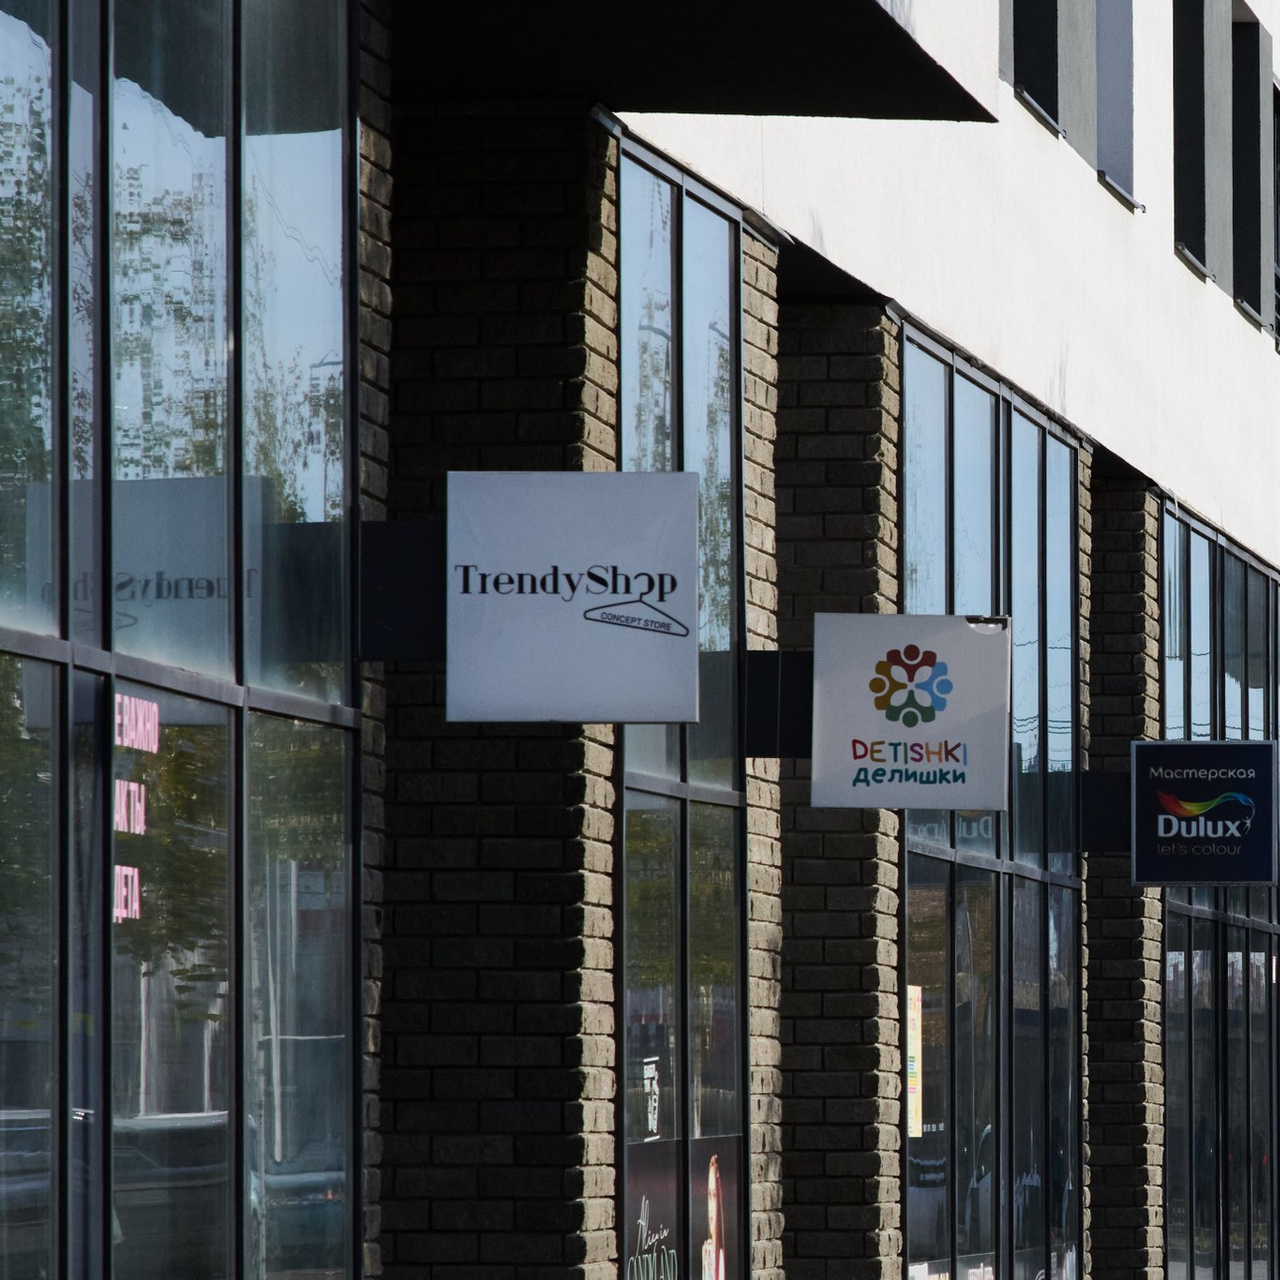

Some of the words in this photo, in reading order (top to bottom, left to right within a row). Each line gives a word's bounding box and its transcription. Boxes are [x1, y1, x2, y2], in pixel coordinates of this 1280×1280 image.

[454, 565, 678, 603] TrendyShop
[600, 611, 642, 626] CONCEPT
[643, 619, 672, 632] STORE
[114, 693, 122, 746] Е
[123, 695, 160, 754] ВАЖНО
[851, 738, 968, 766] DETISHKI
[852, 767, 966, 787] делишки
[1149, 766, 1256, 782] Мастерская
[113, 778, 129, 833] АК
[129, 781, 147, 836] ТЫ
[1157, 814, 1242, 838] Dulux
[1157, 842, 1188, 856] let's
[1191, 842, 1243, 856] colour
[112, 864, 141, 924] ДЕТА
